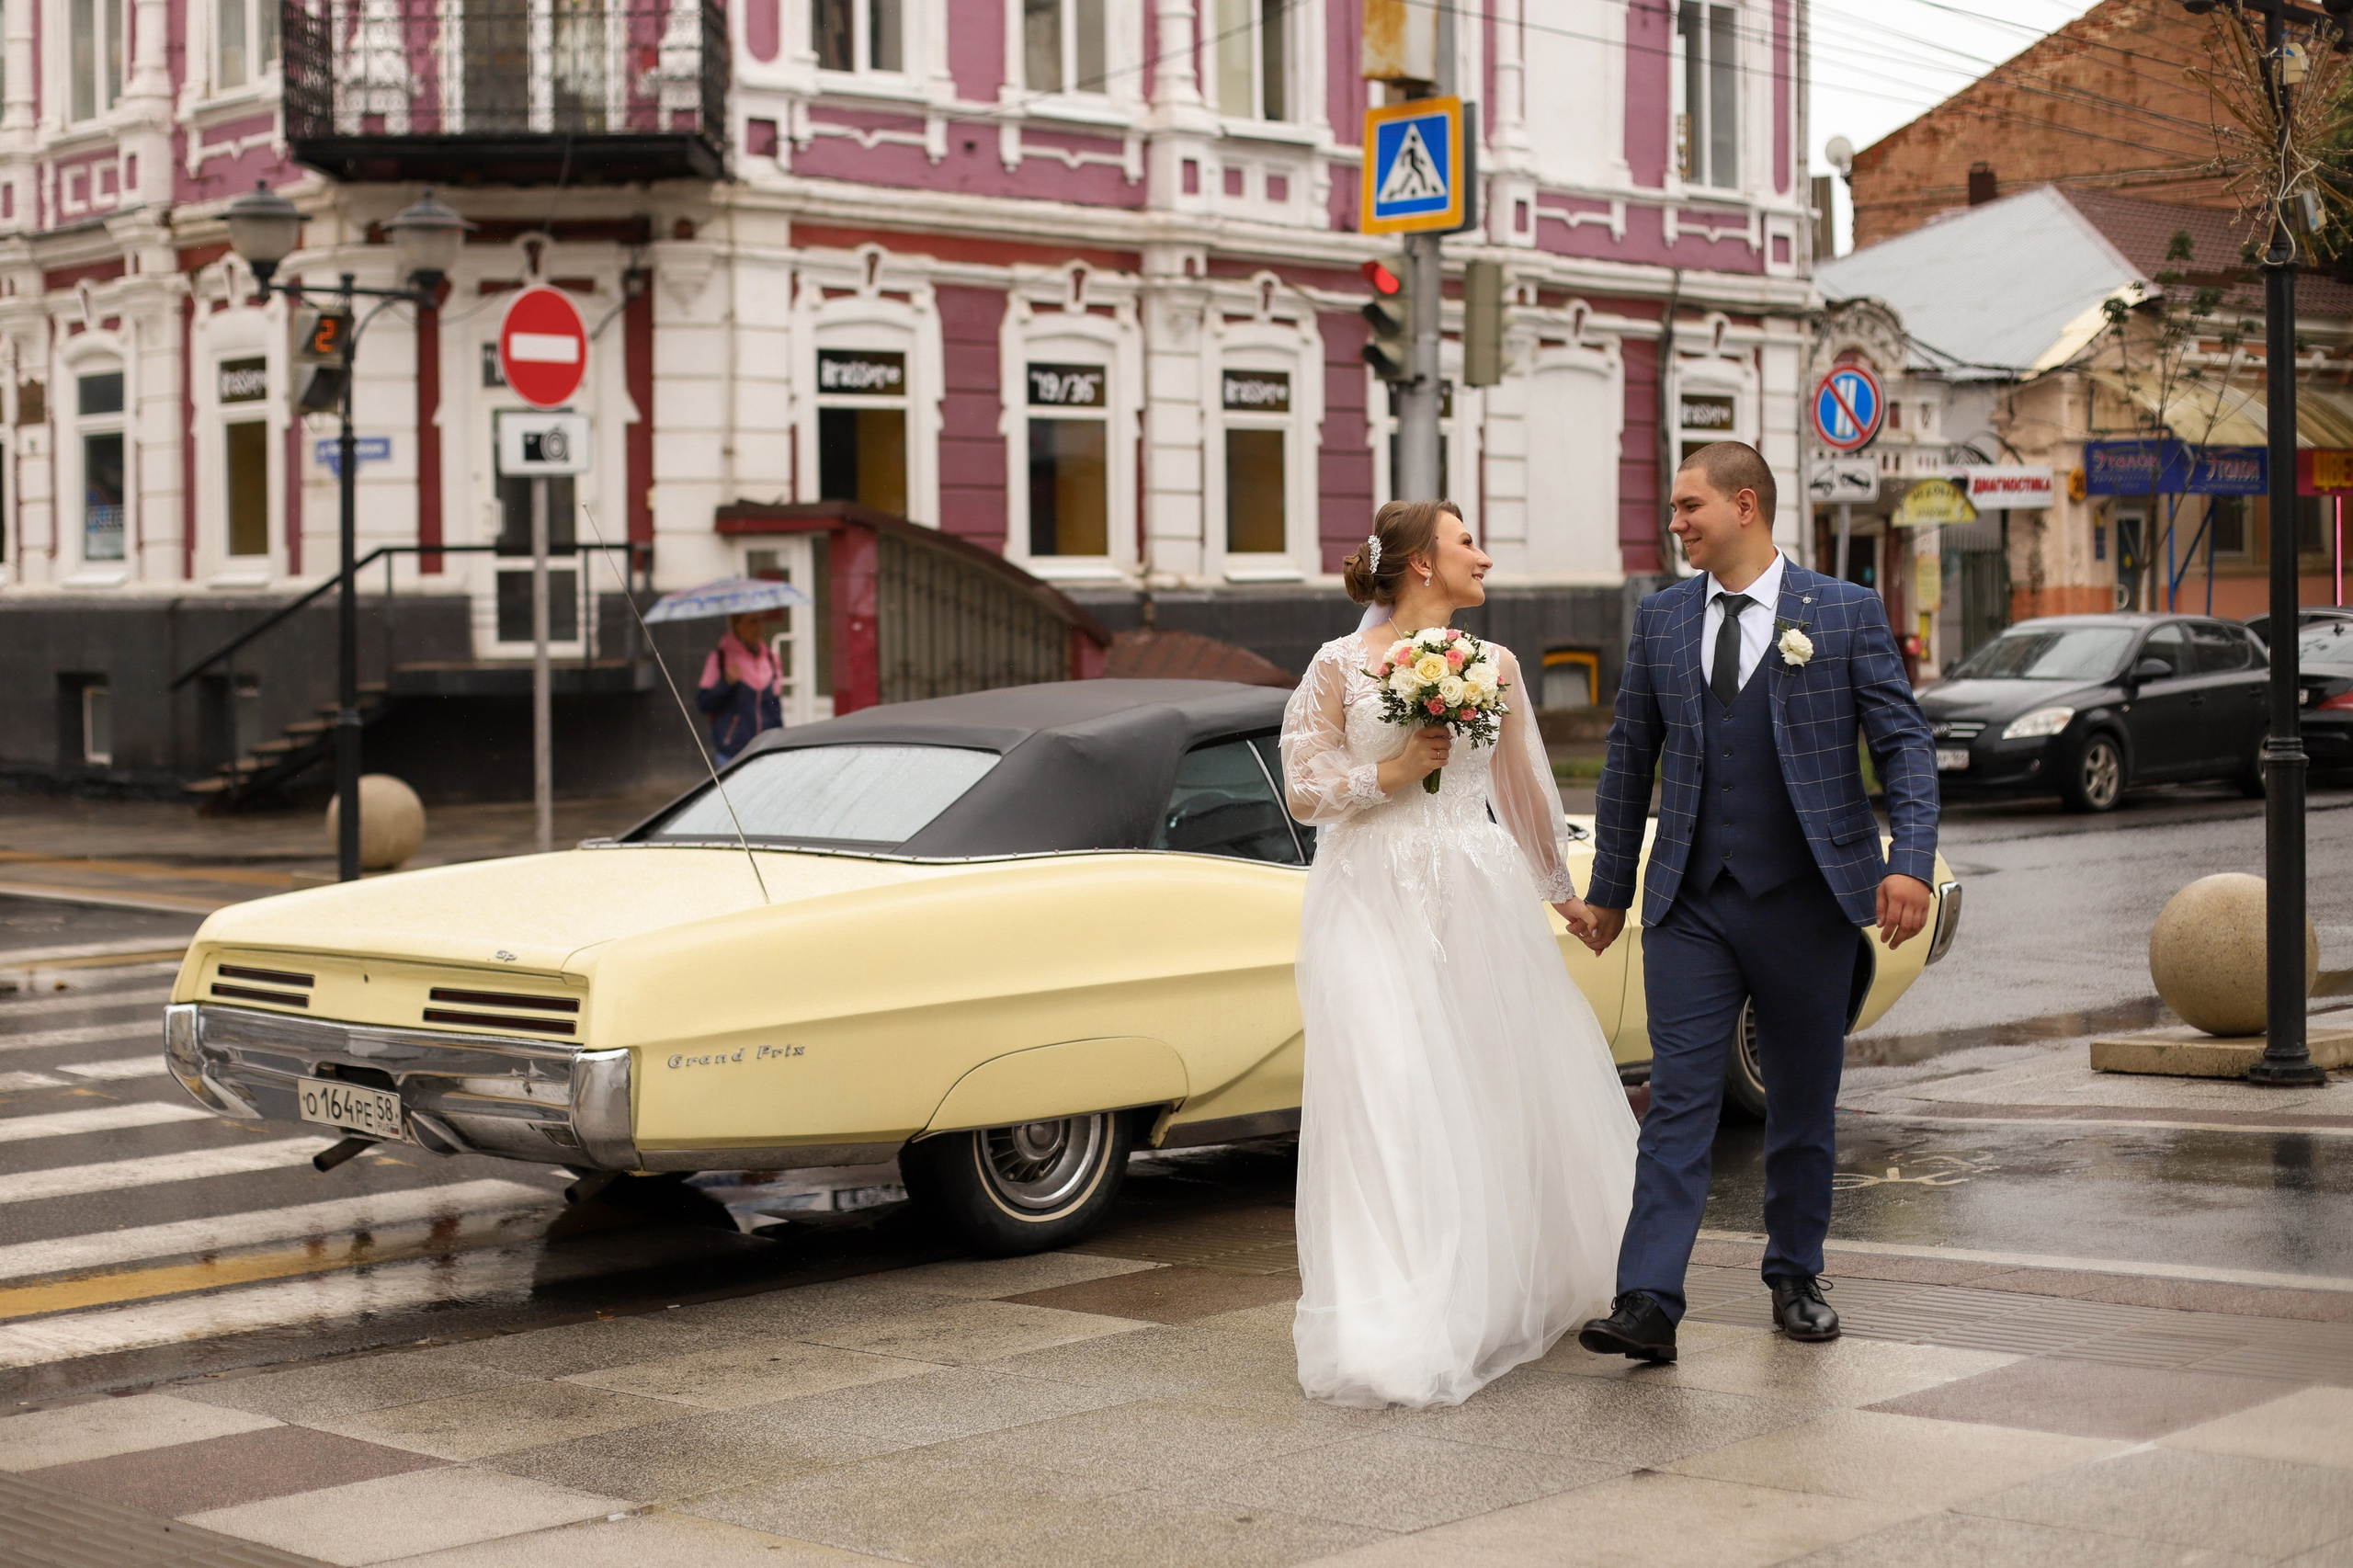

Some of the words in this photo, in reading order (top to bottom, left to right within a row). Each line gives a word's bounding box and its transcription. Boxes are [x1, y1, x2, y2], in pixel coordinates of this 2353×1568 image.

[315, 319, 336, 353] 2
[1973, 477, 2052, 494] ДИАГНОСТИКА
[667, 1048, 745, 1069] Grand
[756, 1044, 805, 1060] Prix
[377, 1096, 393, 1121] 58
